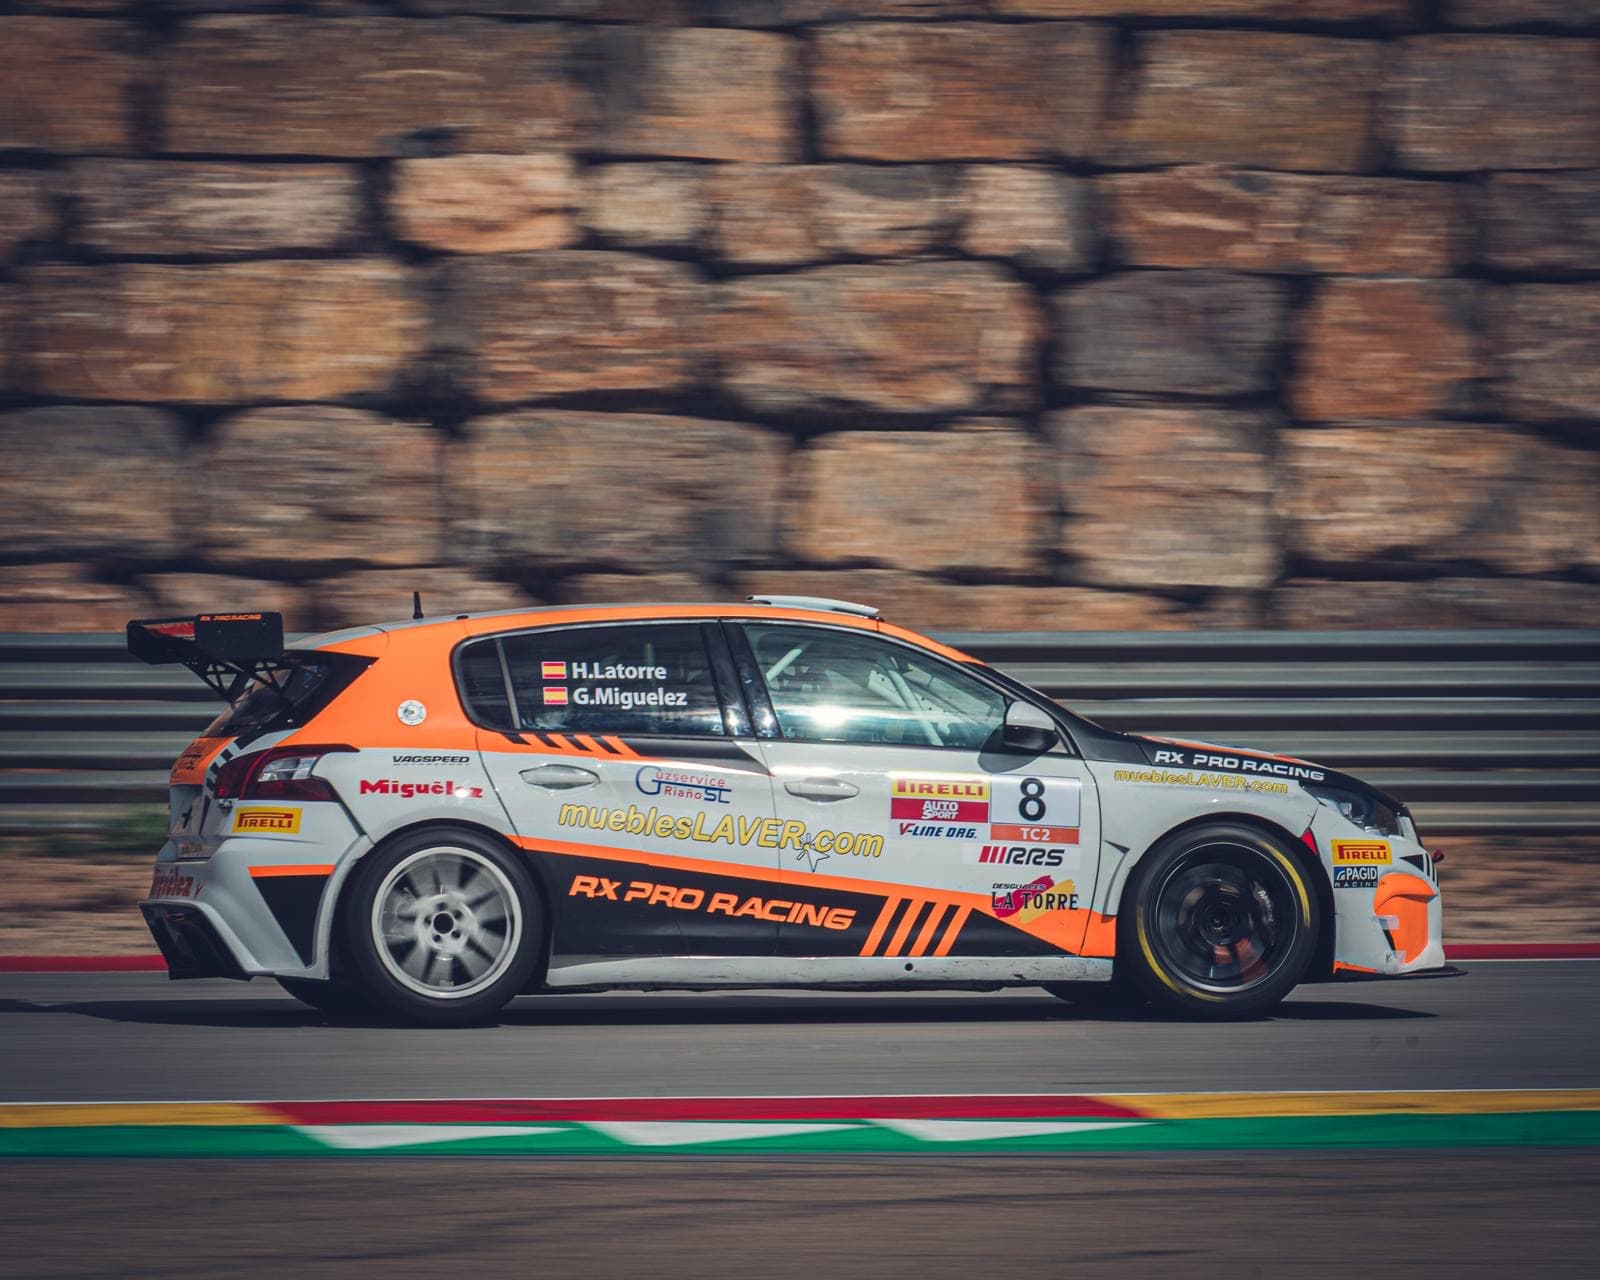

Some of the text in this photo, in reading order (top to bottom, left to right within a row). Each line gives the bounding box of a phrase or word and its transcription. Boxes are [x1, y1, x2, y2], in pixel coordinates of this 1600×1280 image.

[572, 661, 667, 680] H.Latorre
[573, 687, 688, 710] G.Miguelez
[392, 755, 470, 763] VAGSPEED
[1154, 750, 1325, 781] RX PRO RACING
[897, 778, 984, 796] PIRELLI
[1114, 769, 1288, 794] mueblesLAVER.com
[664, 785, 730, 804] Riaño SL
[1018, 777, 1047, 822] 8
[921, 809, 959, 820] SPORT
[922, 800, 959, 811] AUTO
[236, 811, 294, 829] PIRELLI
[558, 802, 885, 858] mueblesLAVER.com
[899, 822, 977, 839] V-LINE ORG.
[1020, 827, 1051, 841] TC2
[1004, 847, 1066, 867] RRS
[1337, 844, 1387, 860] PIRELLI
[1346, 867, 1378, 881] PAGID
[568, 874, 857, 931] RX PRO RACING
[991, 891, 1080, 911] LA TORRE
